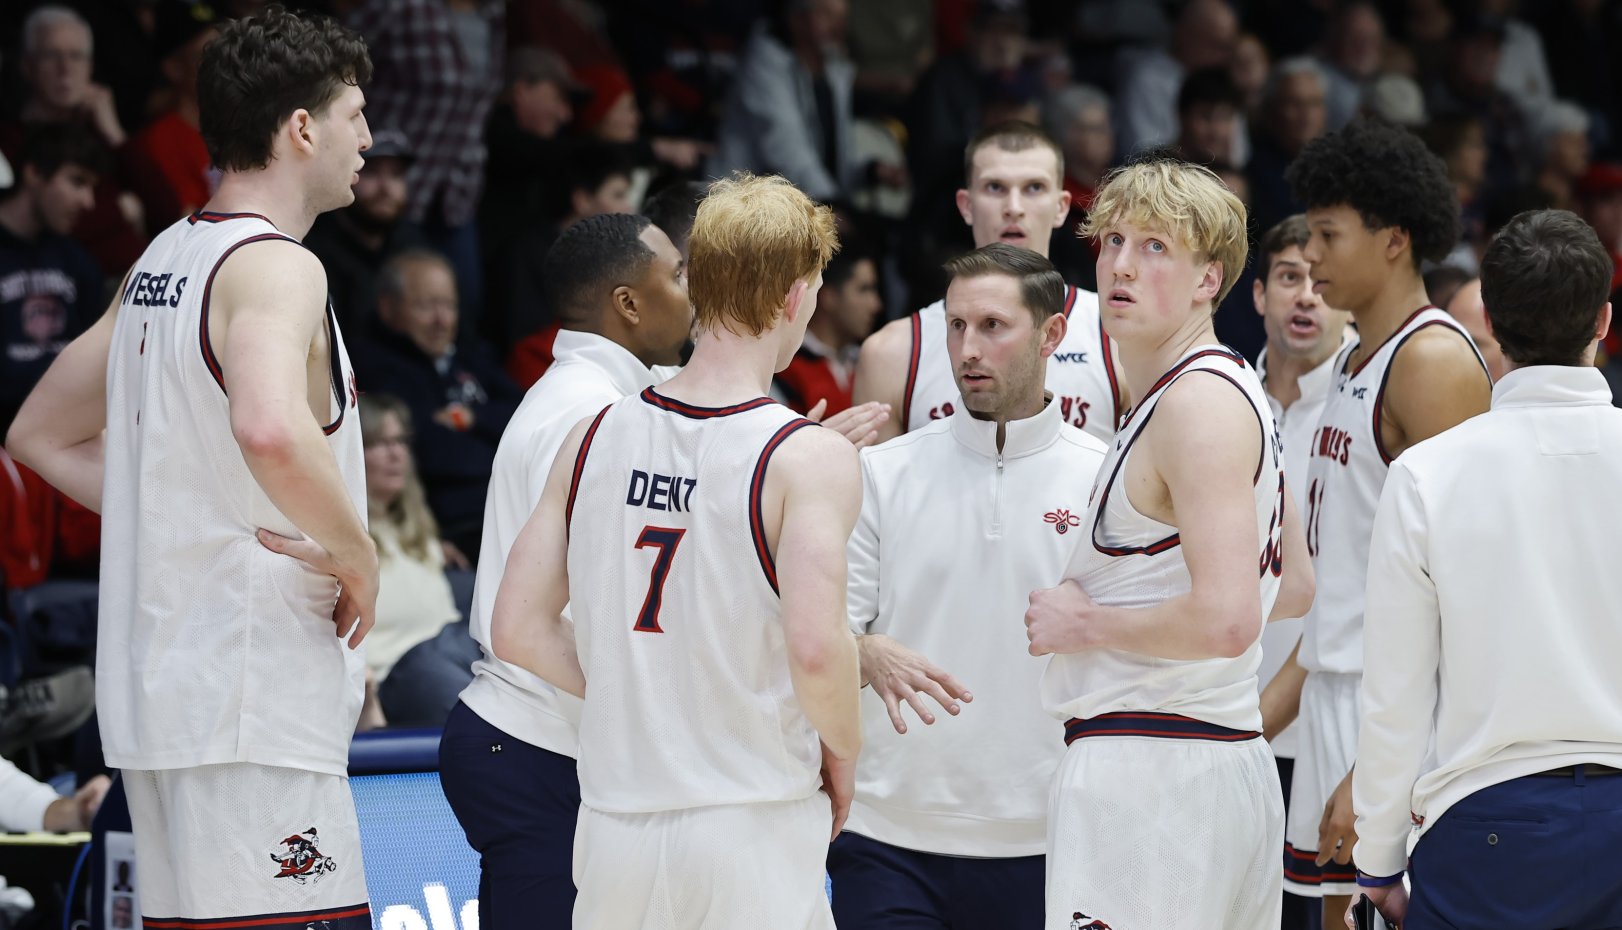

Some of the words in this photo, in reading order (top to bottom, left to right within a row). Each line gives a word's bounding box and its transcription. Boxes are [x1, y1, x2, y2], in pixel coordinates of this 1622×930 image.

[1054, 352, 1089, 364] WCC
[626, 469, 697, 512] DENT
[633, 525, 687, 633] 7
